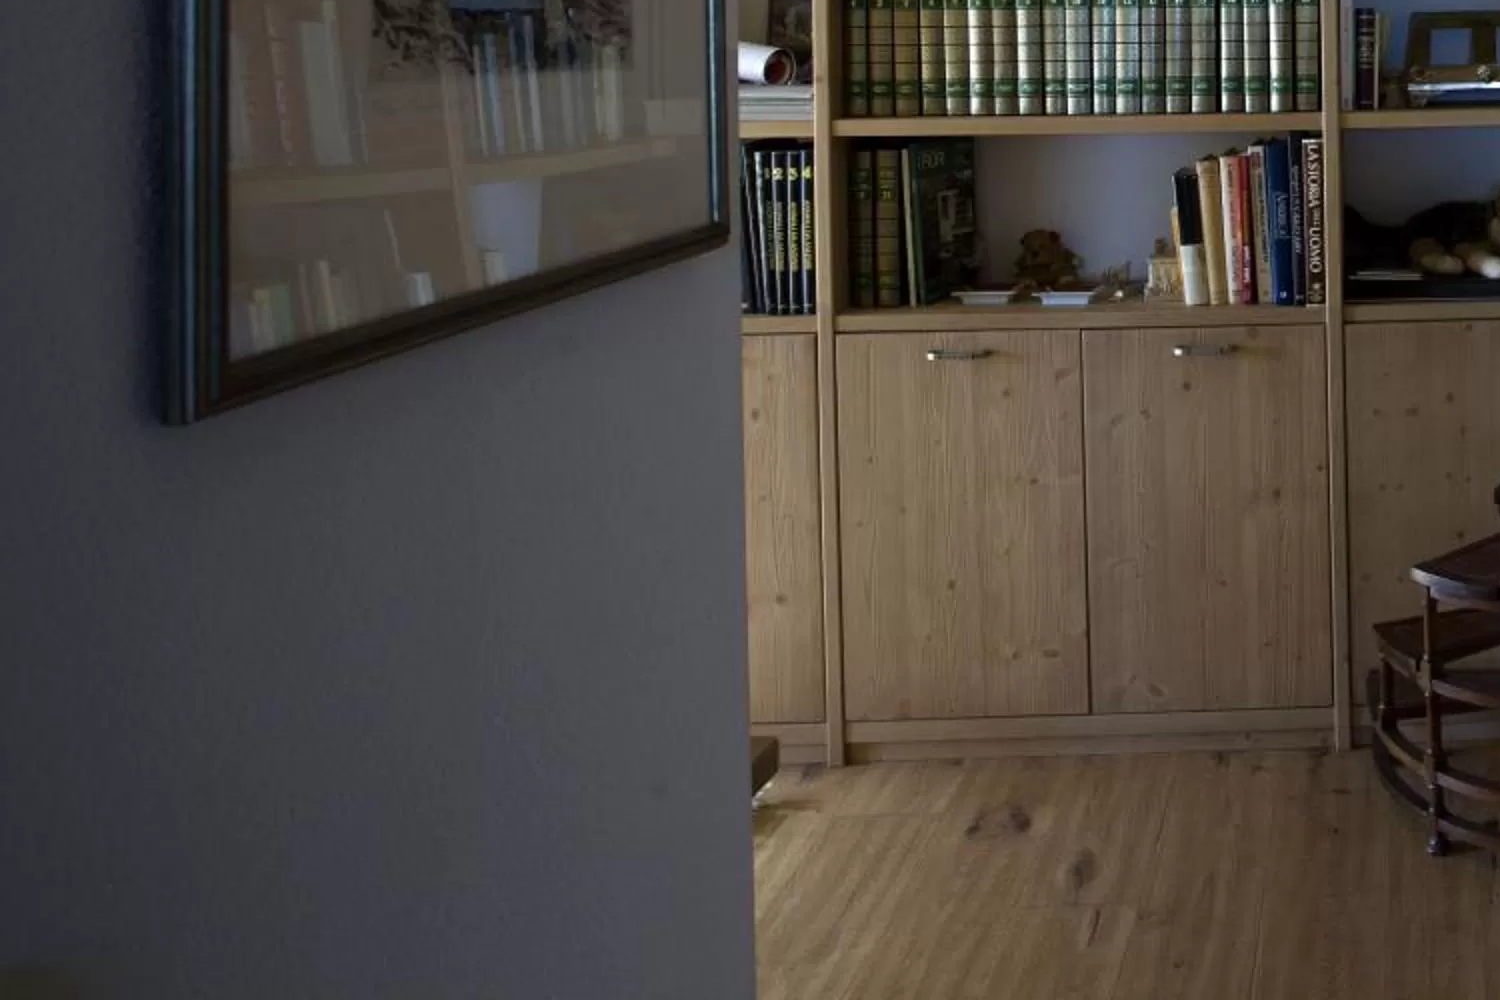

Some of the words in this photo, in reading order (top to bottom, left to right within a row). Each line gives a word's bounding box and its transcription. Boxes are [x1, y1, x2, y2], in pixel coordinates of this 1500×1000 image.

[1307, 144, 1318, 160] LA
[1307, 160, 1320, 207] STORIA
[1309, 227, 1321, 273] UOMO
